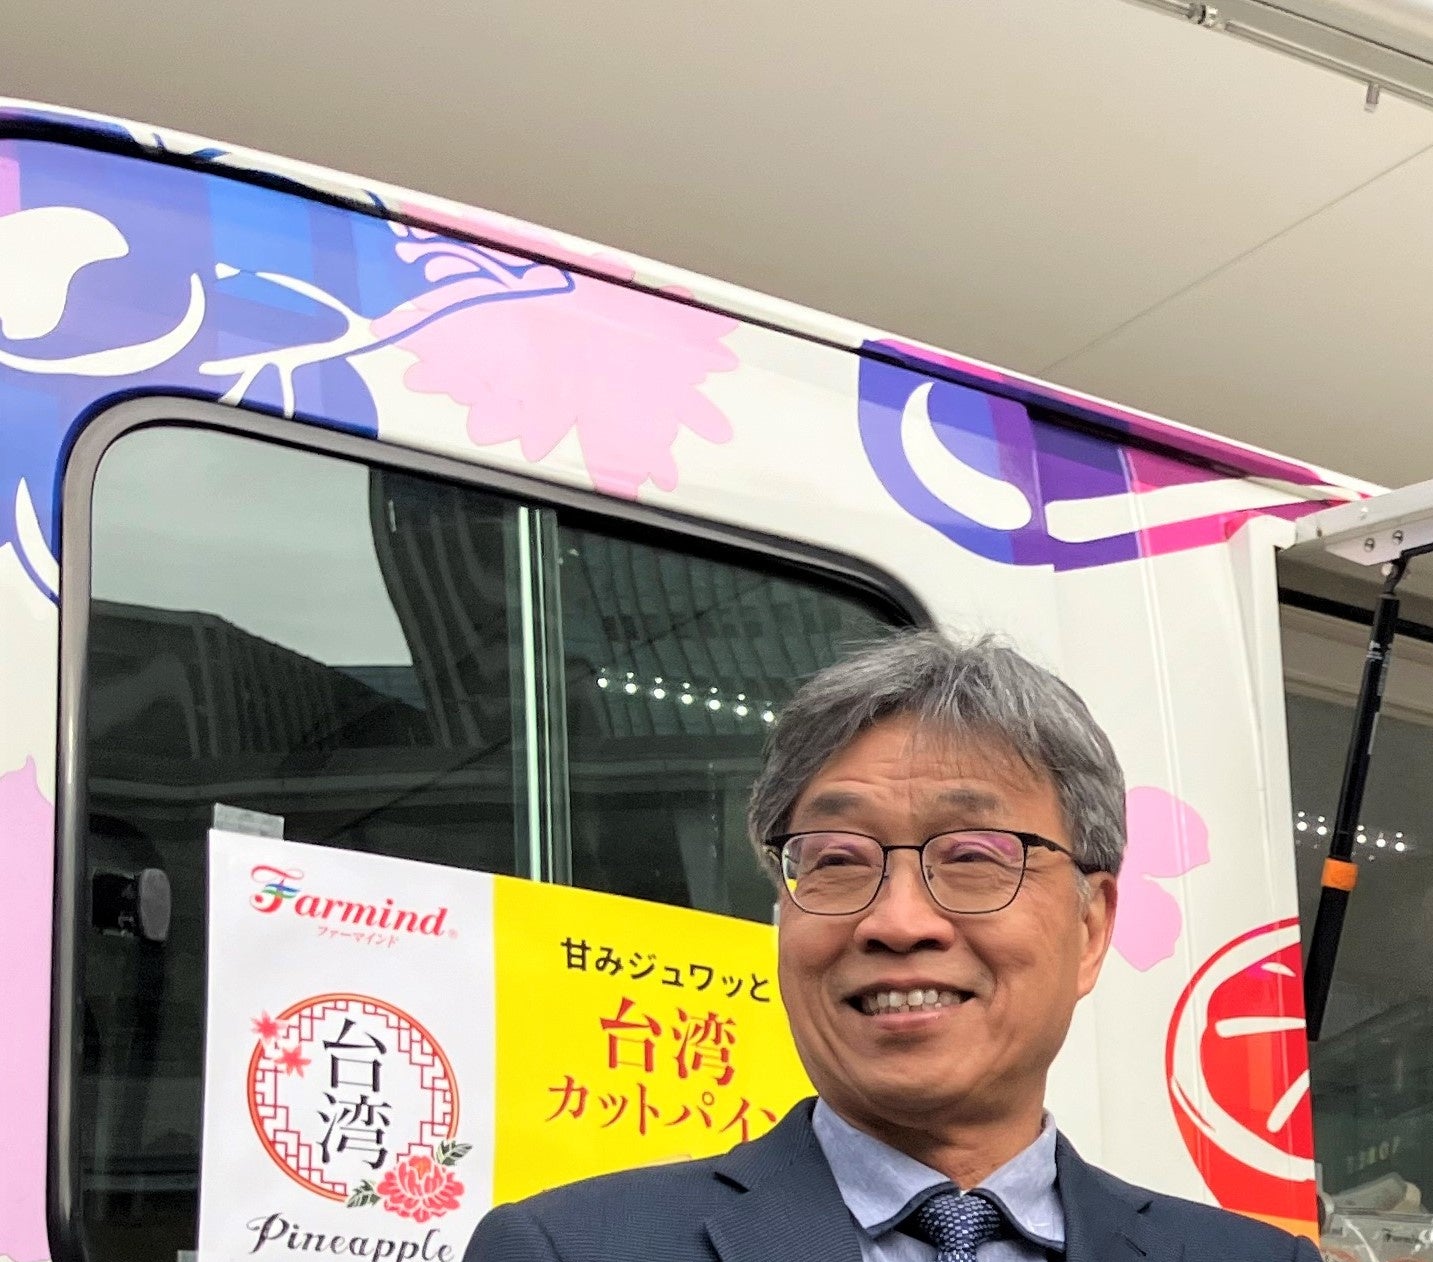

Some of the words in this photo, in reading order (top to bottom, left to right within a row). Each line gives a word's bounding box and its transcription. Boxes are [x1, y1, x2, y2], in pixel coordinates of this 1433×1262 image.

[249, 864, 450, 938] Farmind
[317, 925, 399, 948] ファーマインド
[560, 936, 772, 1003] 甘みジュワッと
[599, 996, 738, 1087] 台湾
[315, 1018, 392, 1170] 台湾
